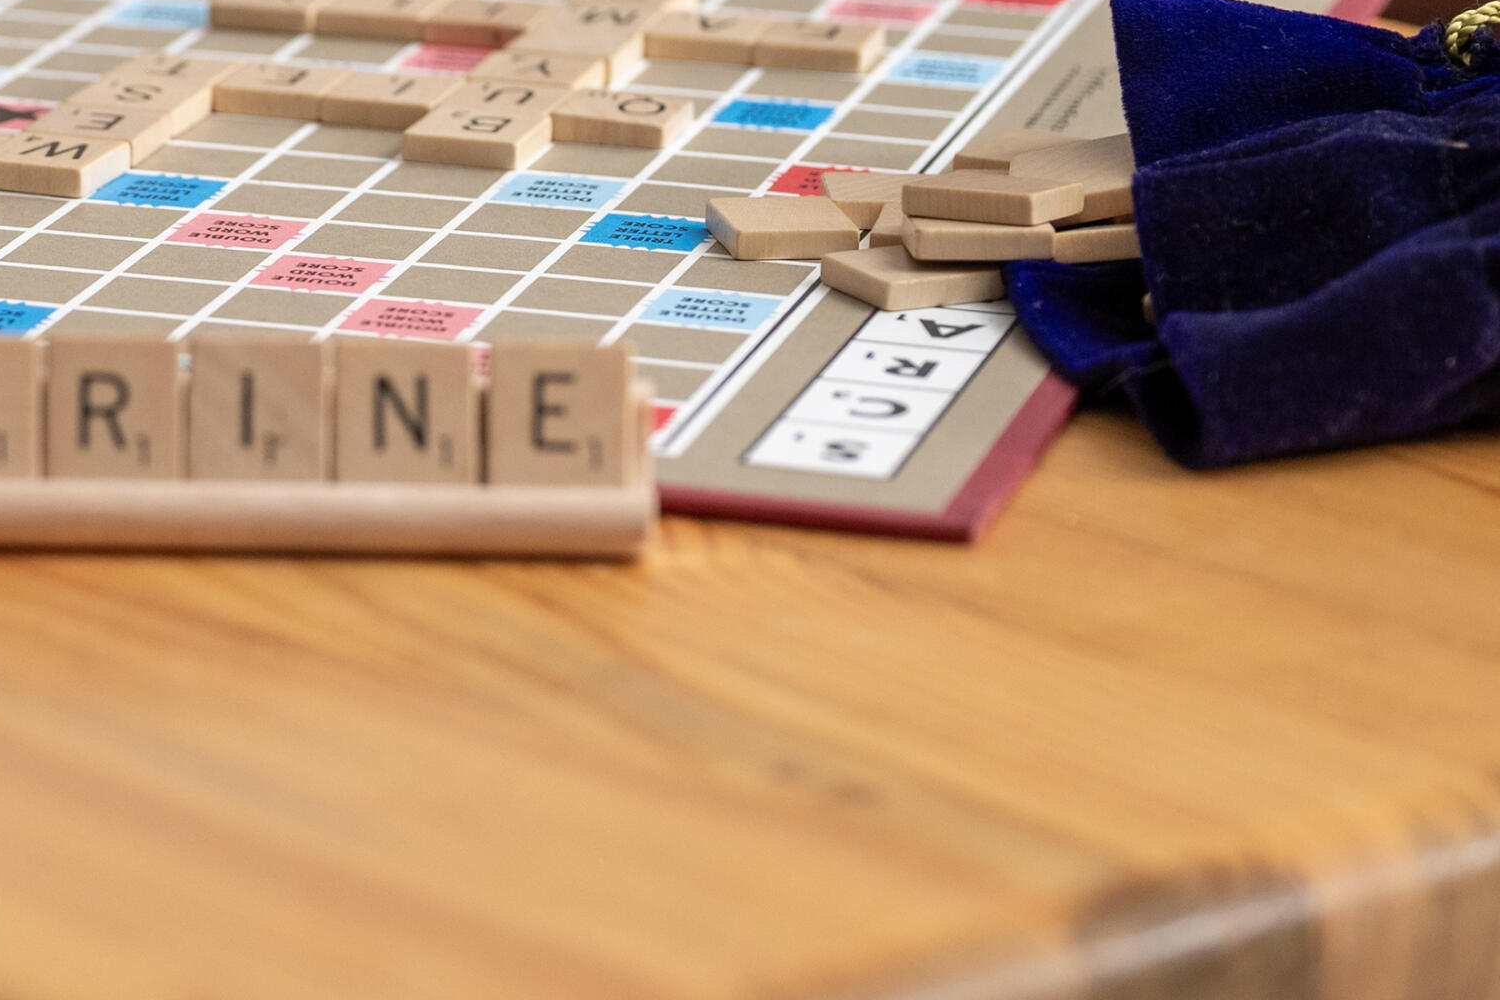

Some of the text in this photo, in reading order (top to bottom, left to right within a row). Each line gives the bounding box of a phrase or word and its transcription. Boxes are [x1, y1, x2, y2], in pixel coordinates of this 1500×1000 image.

[135, 179, 198, 189] SCORE
[534, 180, 599, 189] SCORE
[117, 191, 180, 201] TRIPLE
[126, 185, 190, 196] LETTER
[527, 186, 593, 195] LETTER
[512, 191, 593, 203] DOUBLE
[214, 220, 281, 230] SCORE
[623, 221, 690, 232] SCORE
[207, 226, 269, 236] WORD
[615, 227, 683, 239] LETTER
[188, 232, 272, 244] DOUBLE
[608, 233, 674, 245] TRIPLE
[296, 262, 364, 273] SCORE
[290, 269, 354, 280] WORD
[271, 275, 357, 287] DOUBLE
[386, 307, 454, 318] SCORE
[378, 314, 444, 325] WORD
[360, 320, 447, 333] DOUBLE
